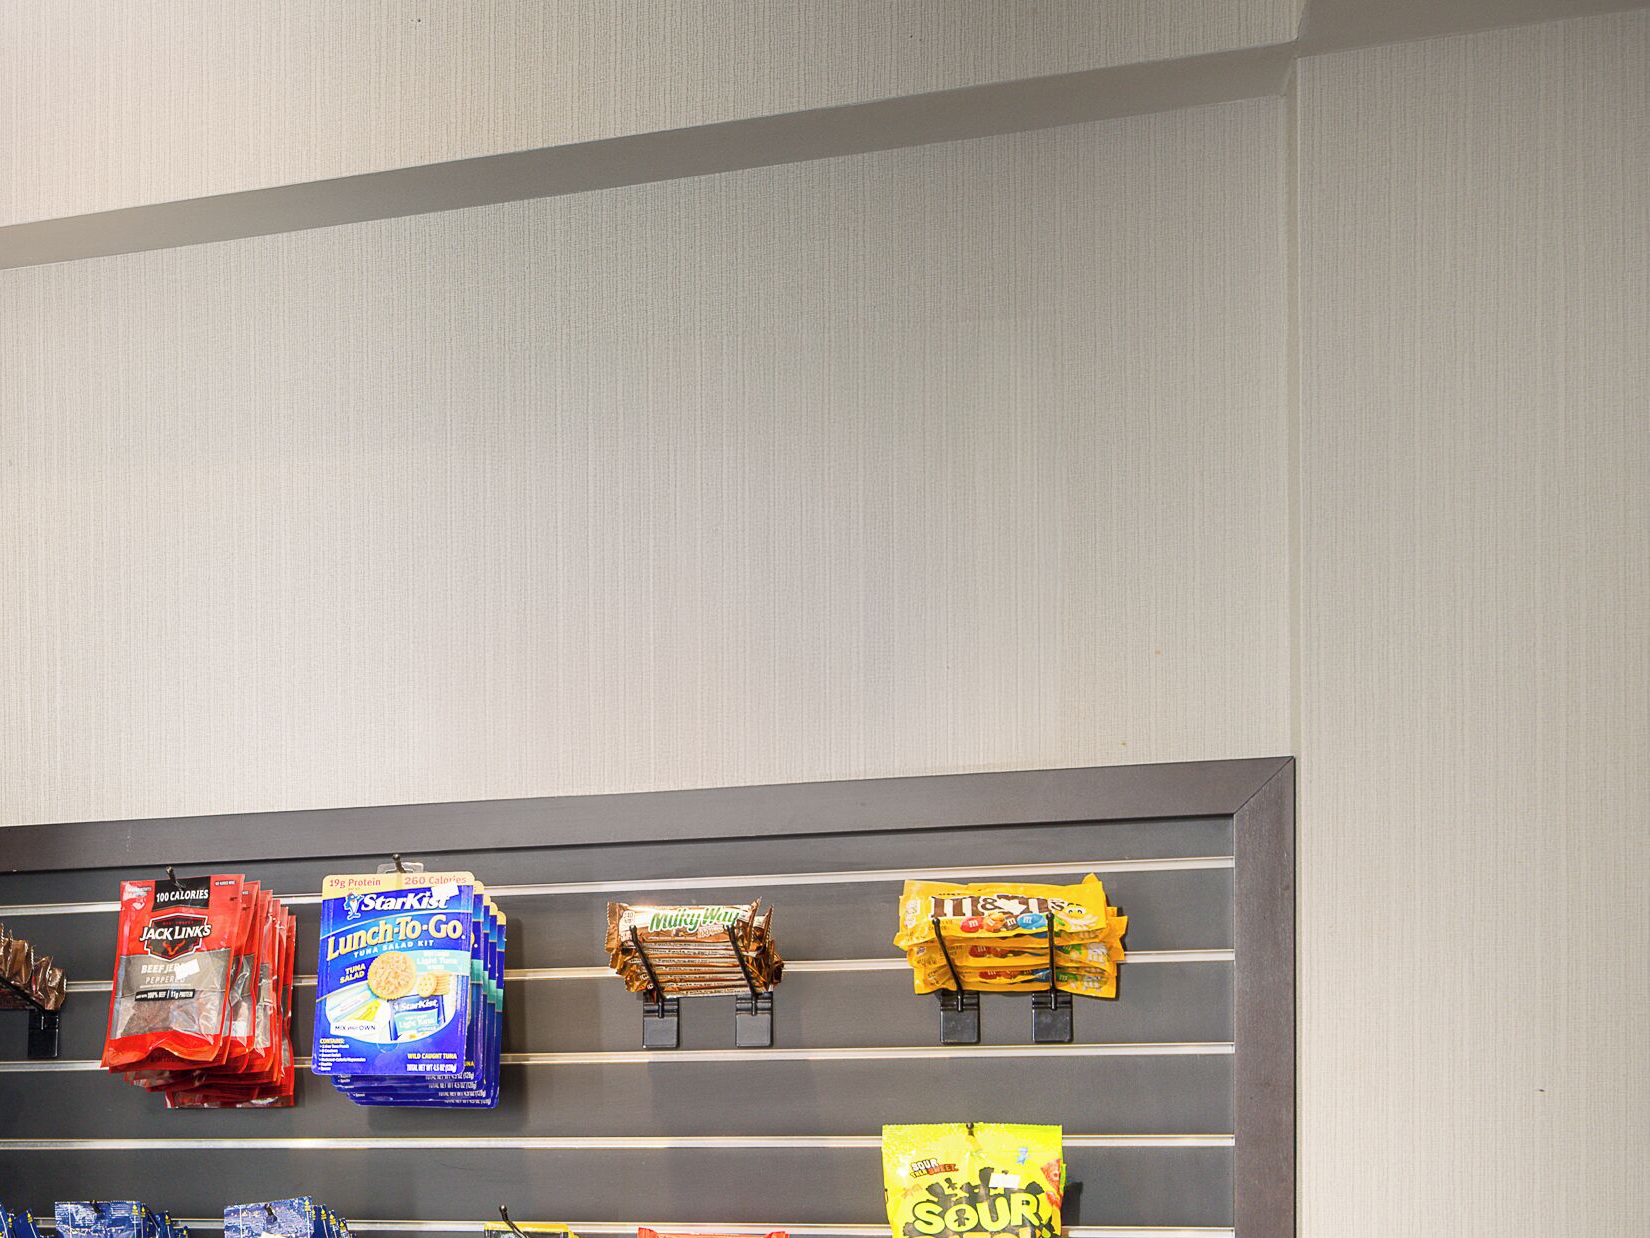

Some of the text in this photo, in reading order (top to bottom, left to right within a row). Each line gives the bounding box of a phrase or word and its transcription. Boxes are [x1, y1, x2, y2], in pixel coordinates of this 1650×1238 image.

[329, 874, 467, 889] 19g Protein 260 Calories
[155, 888, 210, 903] 100 CALORIES
[360, 891, 449, 913] StarKist
[649, 908, 701, 932] Milky
[703, 907, 740, 926] Way
[139, 926, 173, 942] JACK
[354, 939, 435, 958] TUNA SALAD KIT
[141, 962, 165, 975] BEEF
[345, 963, 367, 975] TUNA
[339, 971, 366, 985] SALAD
[179, 989, 193, 999] PROTEIN
[443, 1052, 458, 1060] TUNA
[911, 1158, 939, 1171] SOUR
[910, 1168, 928, 1178] THEN
[913, 1191, 1041, 1236] SOUR
